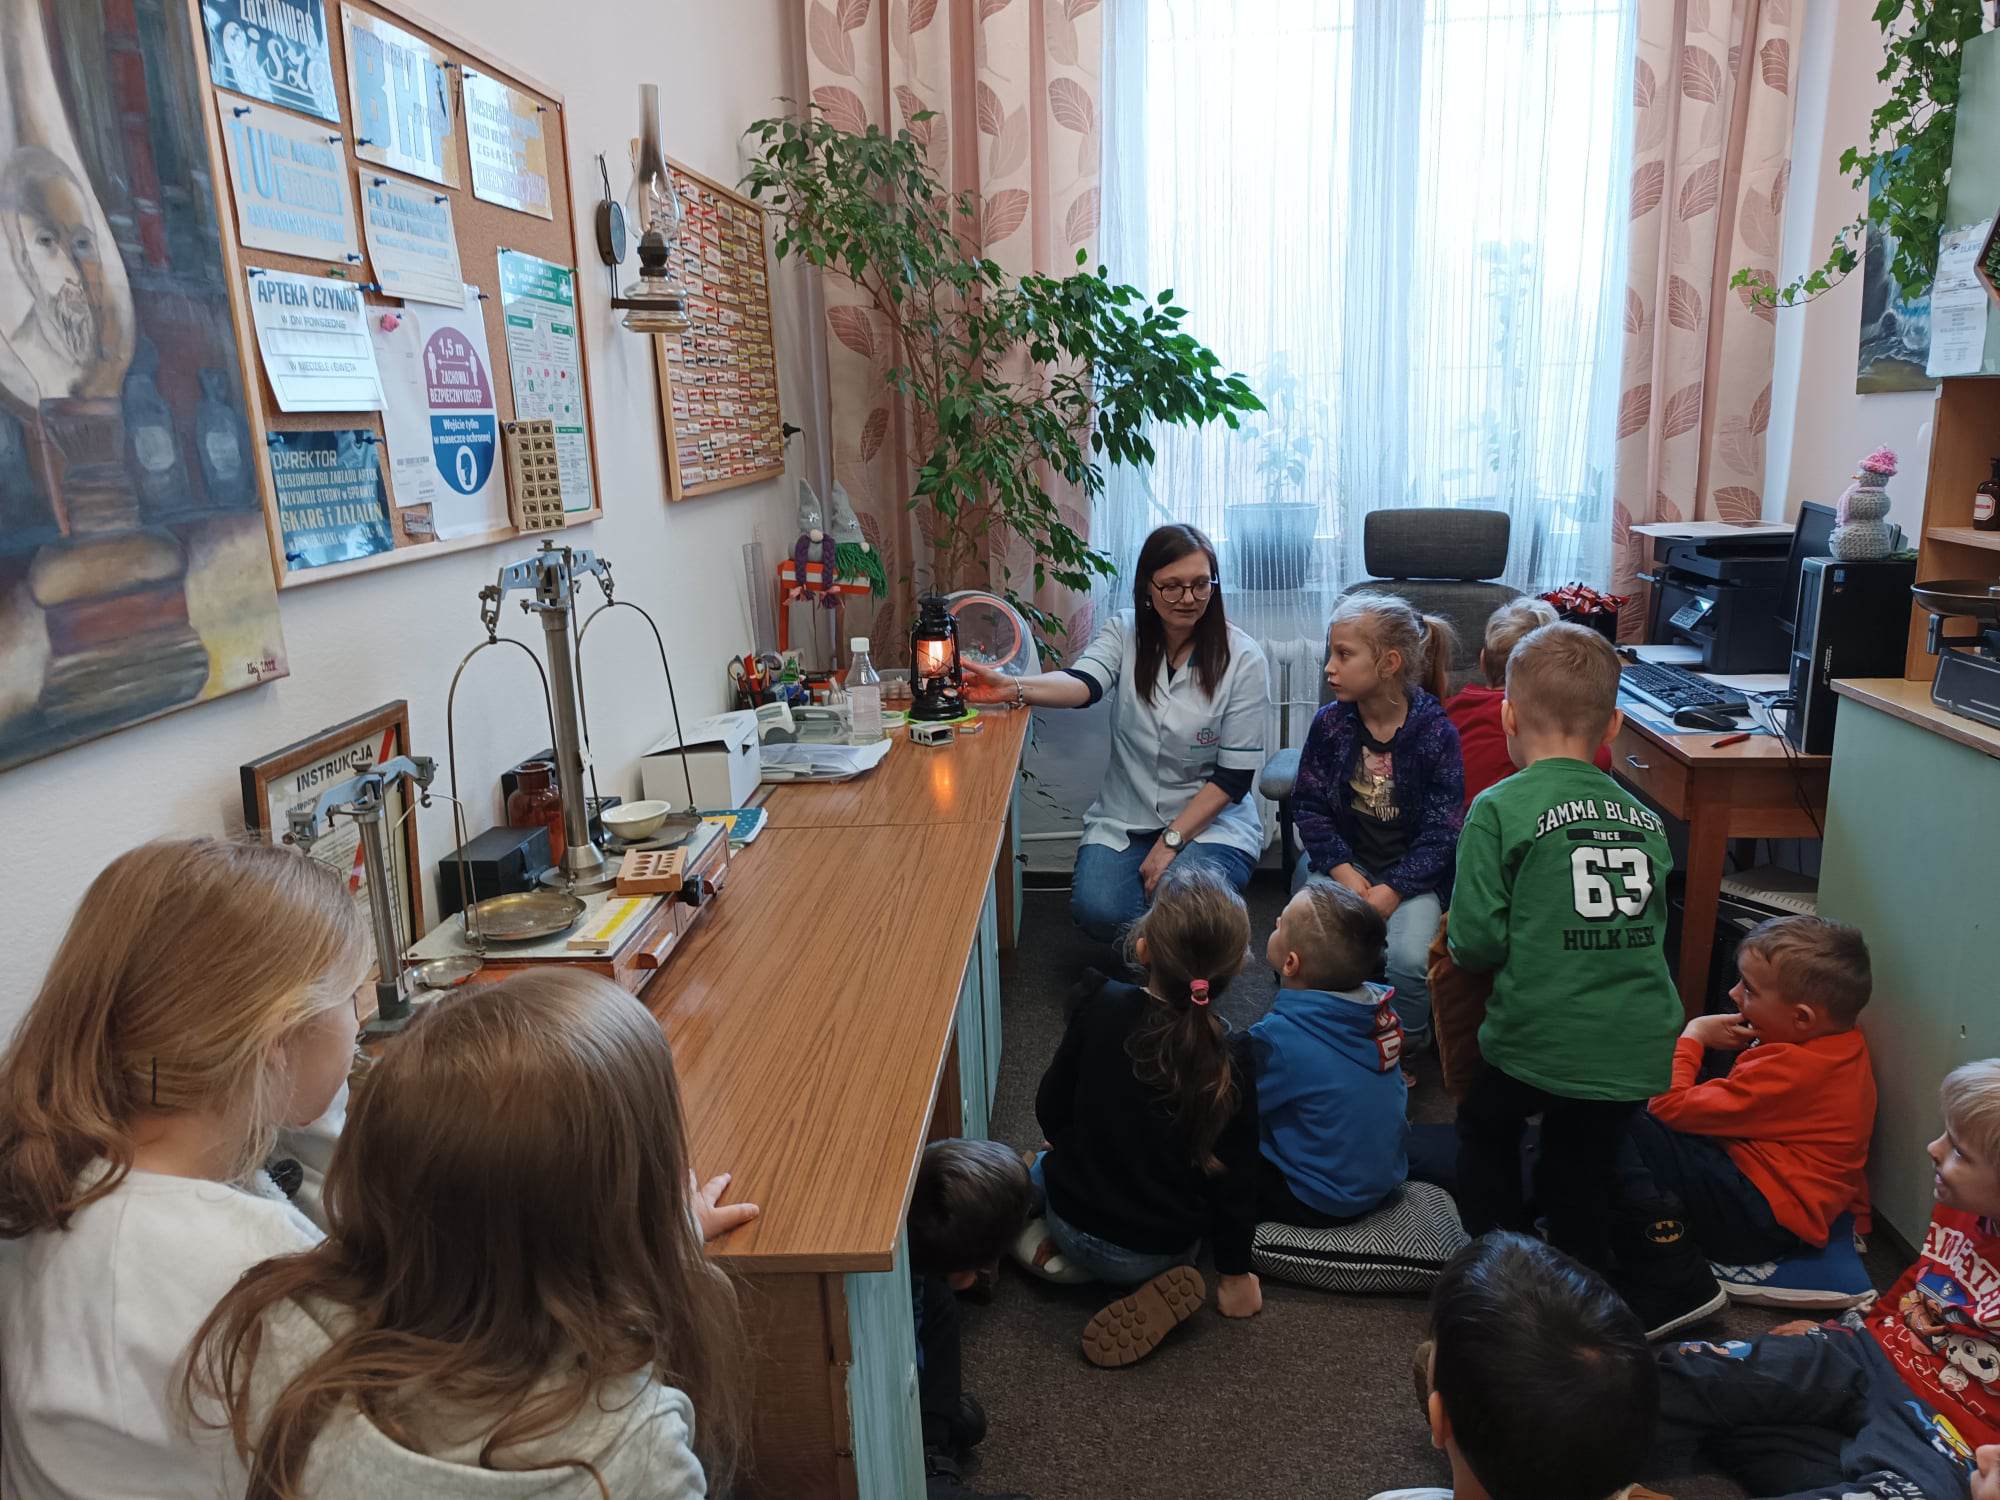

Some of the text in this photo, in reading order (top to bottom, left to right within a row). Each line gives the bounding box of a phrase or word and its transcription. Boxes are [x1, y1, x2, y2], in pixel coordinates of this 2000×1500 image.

[257, 280, 360, 313] APTEKA CZYNNA
[438, 337, 465, 358] 1,5 m
[440, 369, 470, 385] ZACHOWAJ
[429, 387, 464, 404] BEZPIECZNY
[442, 418, 480, 433] Wejście tylko
[272, 450, 338, 470] DYREKTOR
[281, 507, 326, 533] SKARG
[296, 743, 374, 792] INSTRUKCJA
[1592, 830, 1621, 841] SINCE
[1570, 846, 1653, 919] 63
[1562, 929, 1622, 951] HULK
